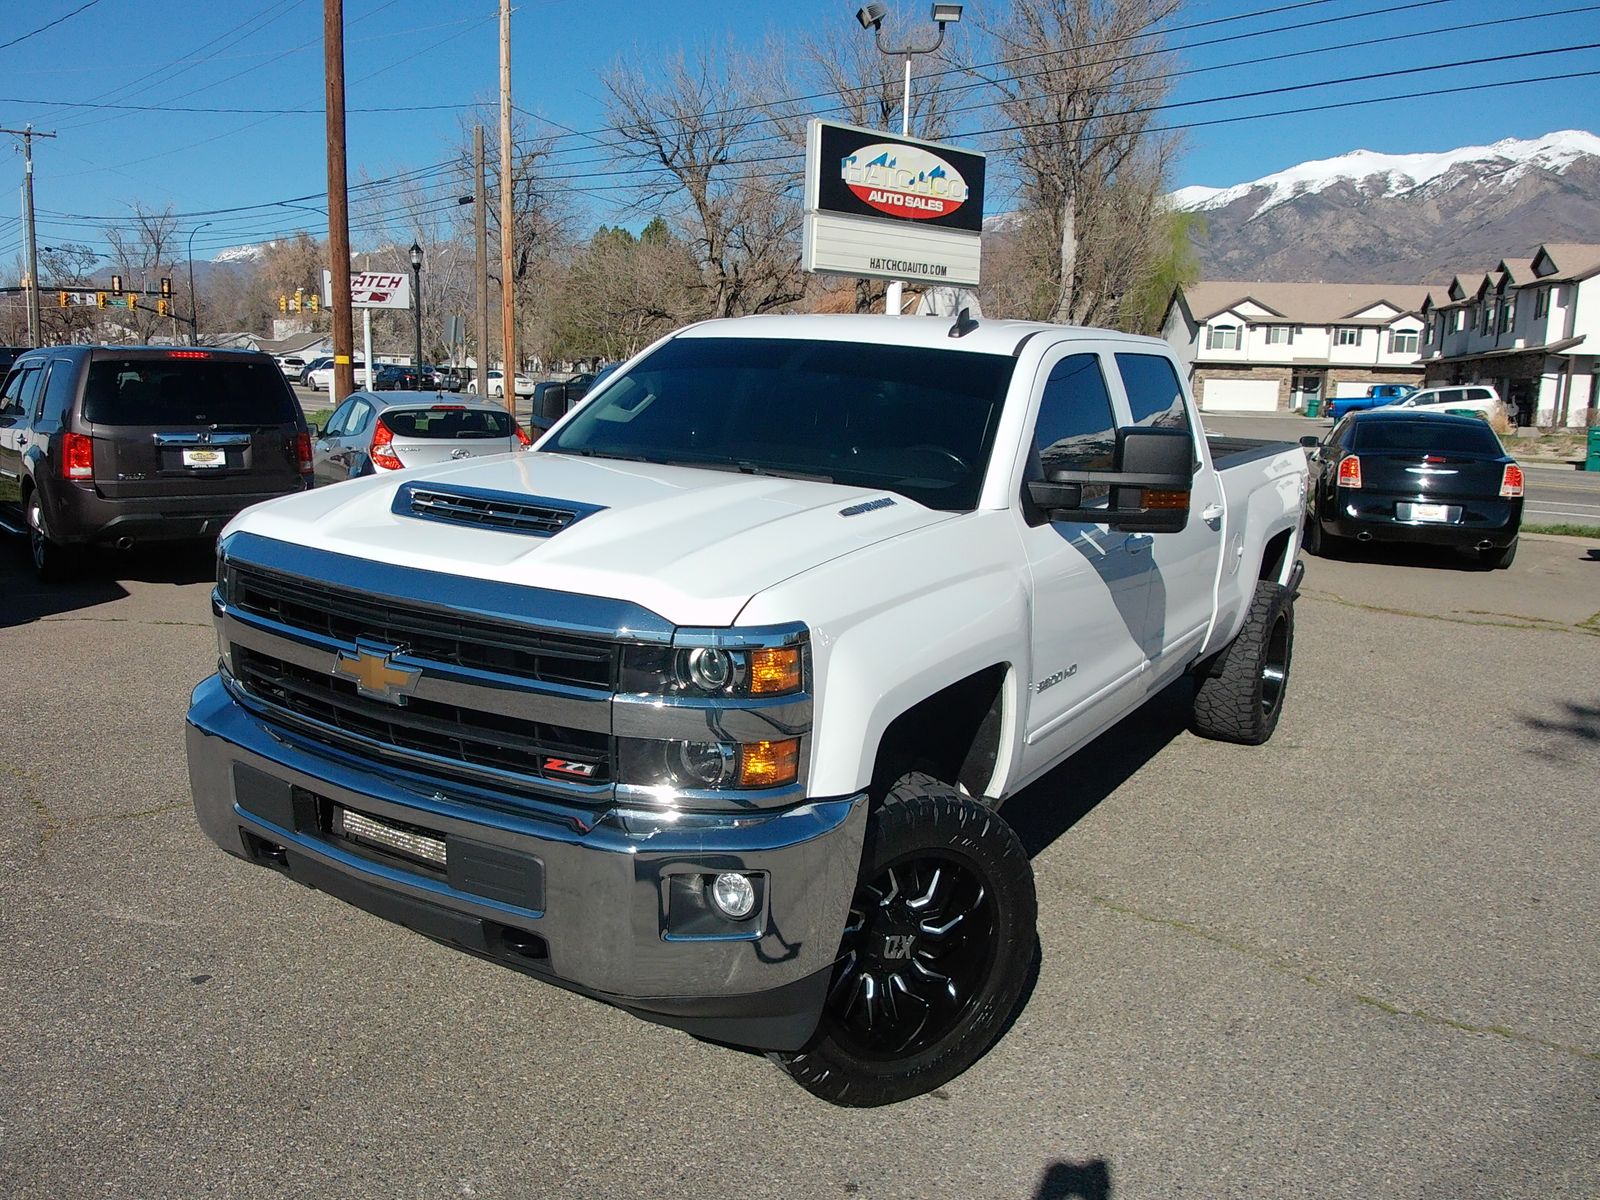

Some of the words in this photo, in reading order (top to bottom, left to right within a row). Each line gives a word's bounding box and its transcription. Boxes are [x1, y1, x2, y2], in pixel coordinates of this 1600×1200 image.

[868, 190, 903, 206] AUTO
[904, 195, 944, 212] SALES
[869, 257, 947, 276] HATCHCOAUTO.COM
[351, 275, 403, 289] ATCH
[543, 757, 594, 777] Z71
